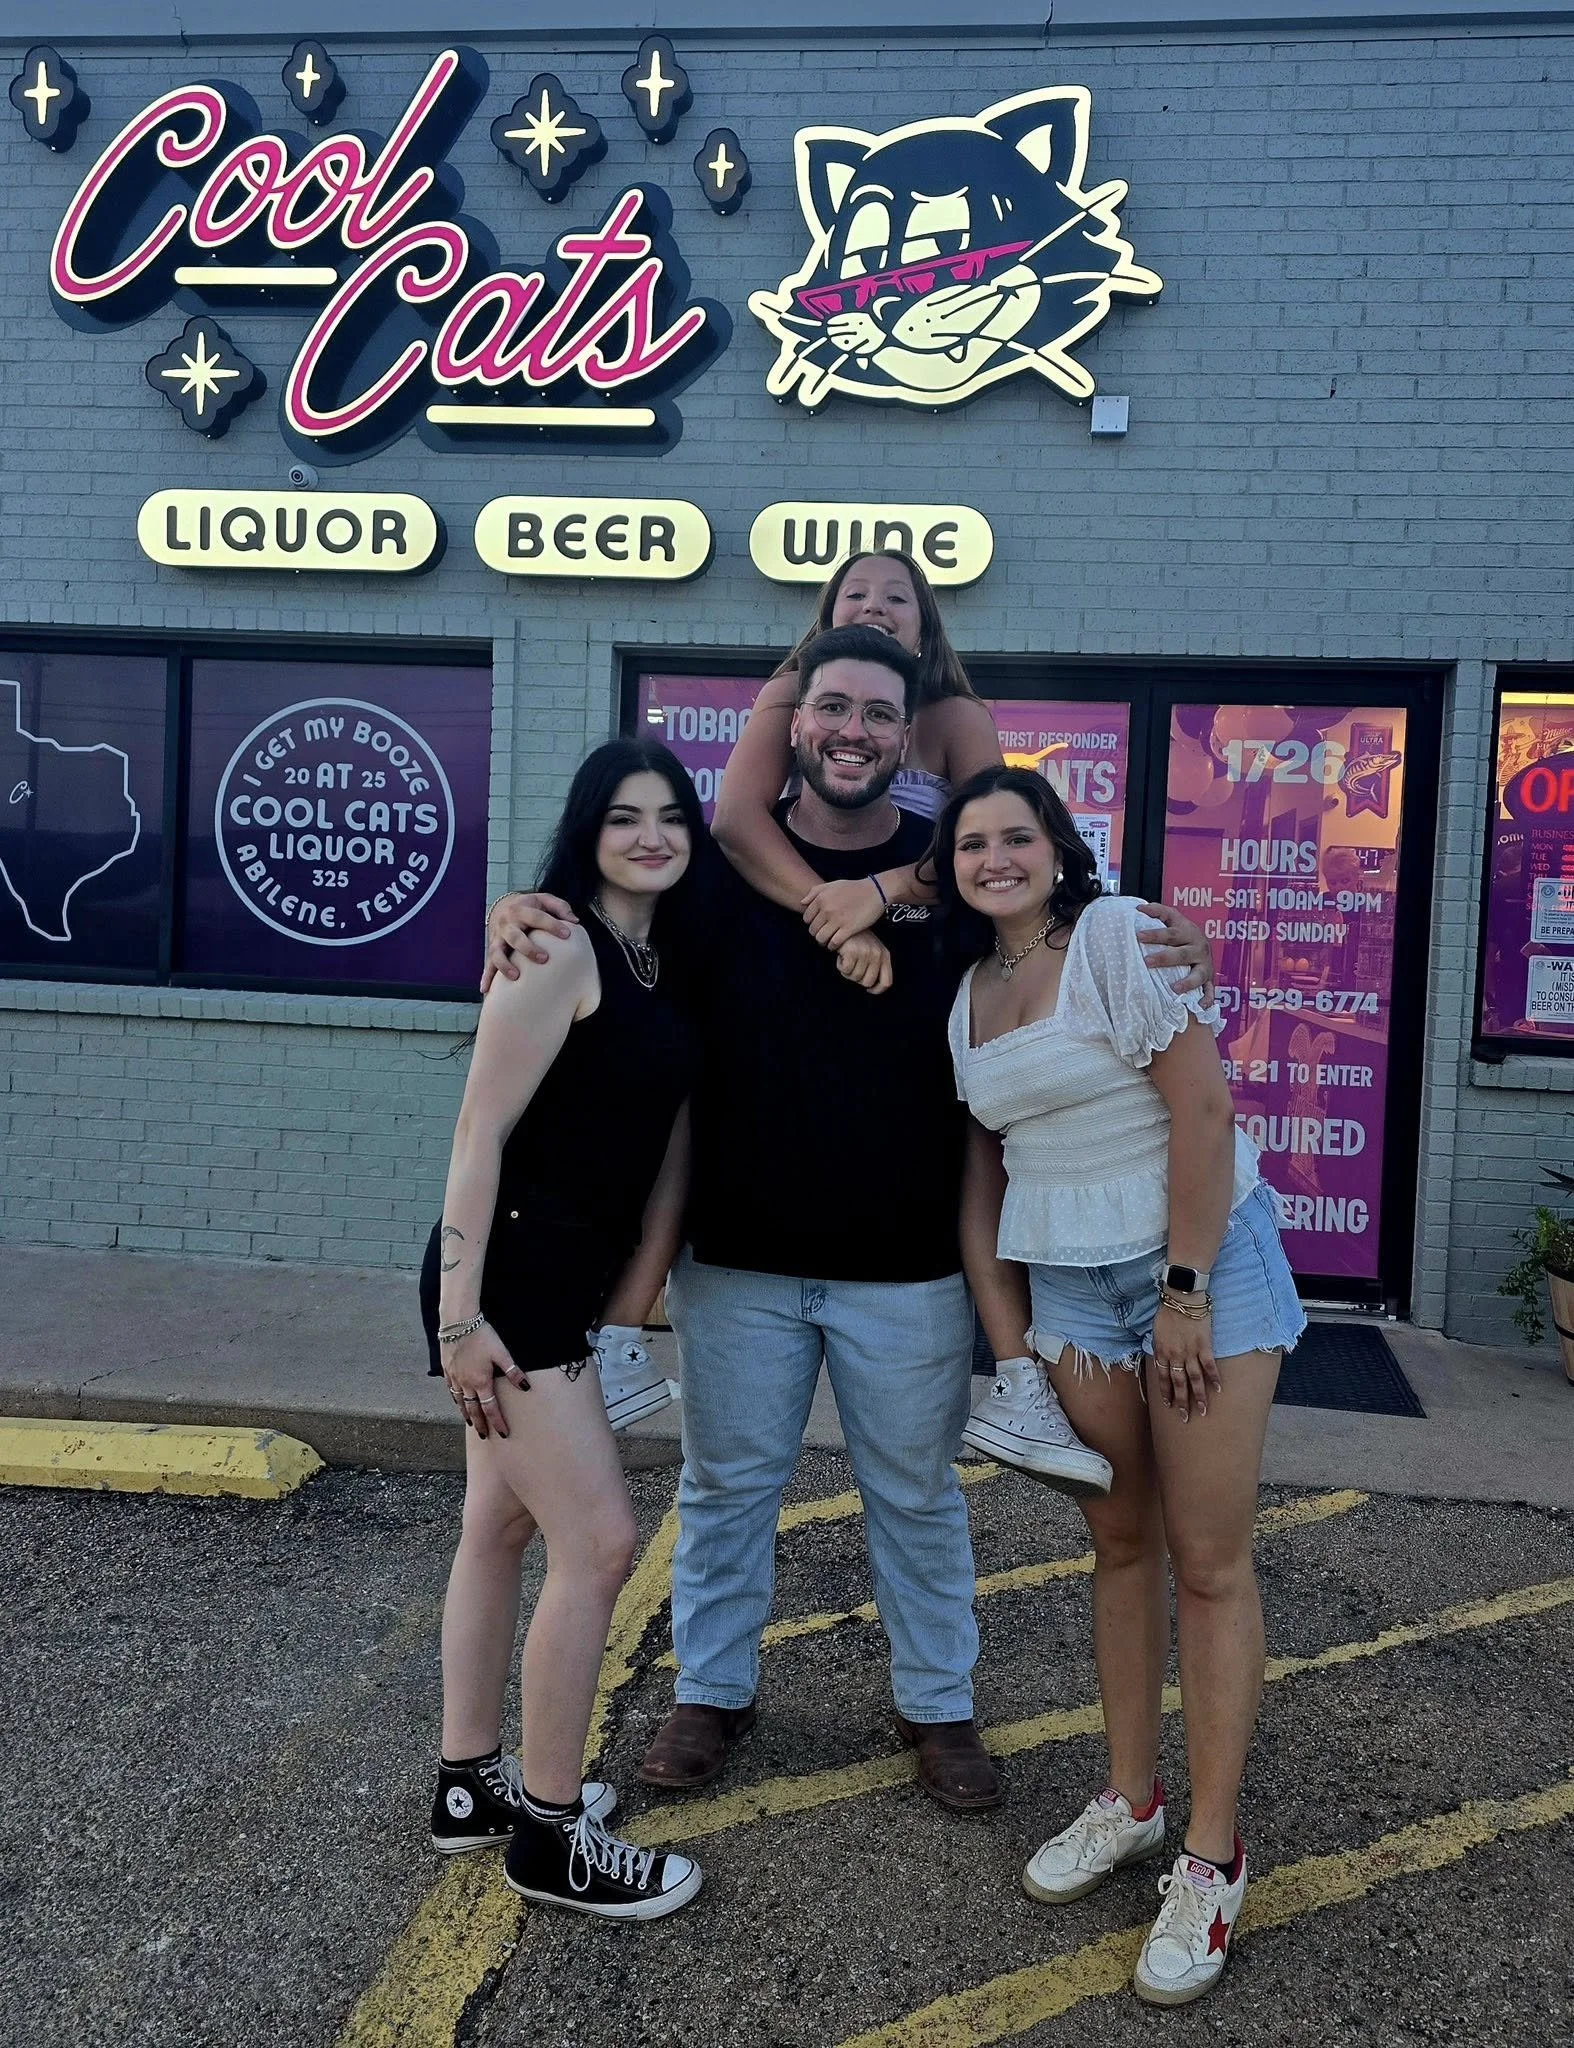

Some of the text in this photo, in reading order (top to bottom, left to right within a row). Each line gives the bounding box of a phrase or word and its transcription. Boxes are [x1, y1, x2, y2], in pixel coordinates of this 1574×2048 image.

[50, 50, 459, 302] Cool
[285, 189, 706, 436] Cats
[166, 505, 407, 555] LIQUOR
[507, 512, 676, 562] BEER
[997, 731, 1035, 749] FIRST
[243, 716, 430, 796] I GET MY BOOZE
[1221, 739, 1346, 785] 1726
[284, 762, 387, 790] 20 AT 25
[230, 794, 439, 835] COOL CATS
[269, 832, 395, 865] LIQUOR
[1220, 838, 1318, 873] HOURS
[1530, 852, 1548, 861] TUE
[312, 869, 349, 888] 325
[1529, 863, 1551, 871] WED
[236, 843, 430, 929] ABILENE, TEXAS
[1266, 887, 1382, 913] 10AM-9PM
[892, 904, 931, 922] Cats
[1204, 919, 1348, 944] CLOSED SUNDAY
[1540, 926, 1550, 935] BE
[1248, 987, 1379, 1014] 529-6774
[1531, 1000, 1552, 1011] BEER
[1553, 1002, 1565, 1012] ON
[1536, 990, 1547, 1001] TO
[1248, 1059, 1279, 1083] 21
[1287, 1062, 1310, 1084] TO
[1316, 1064, 1373, 1087] ENTER
